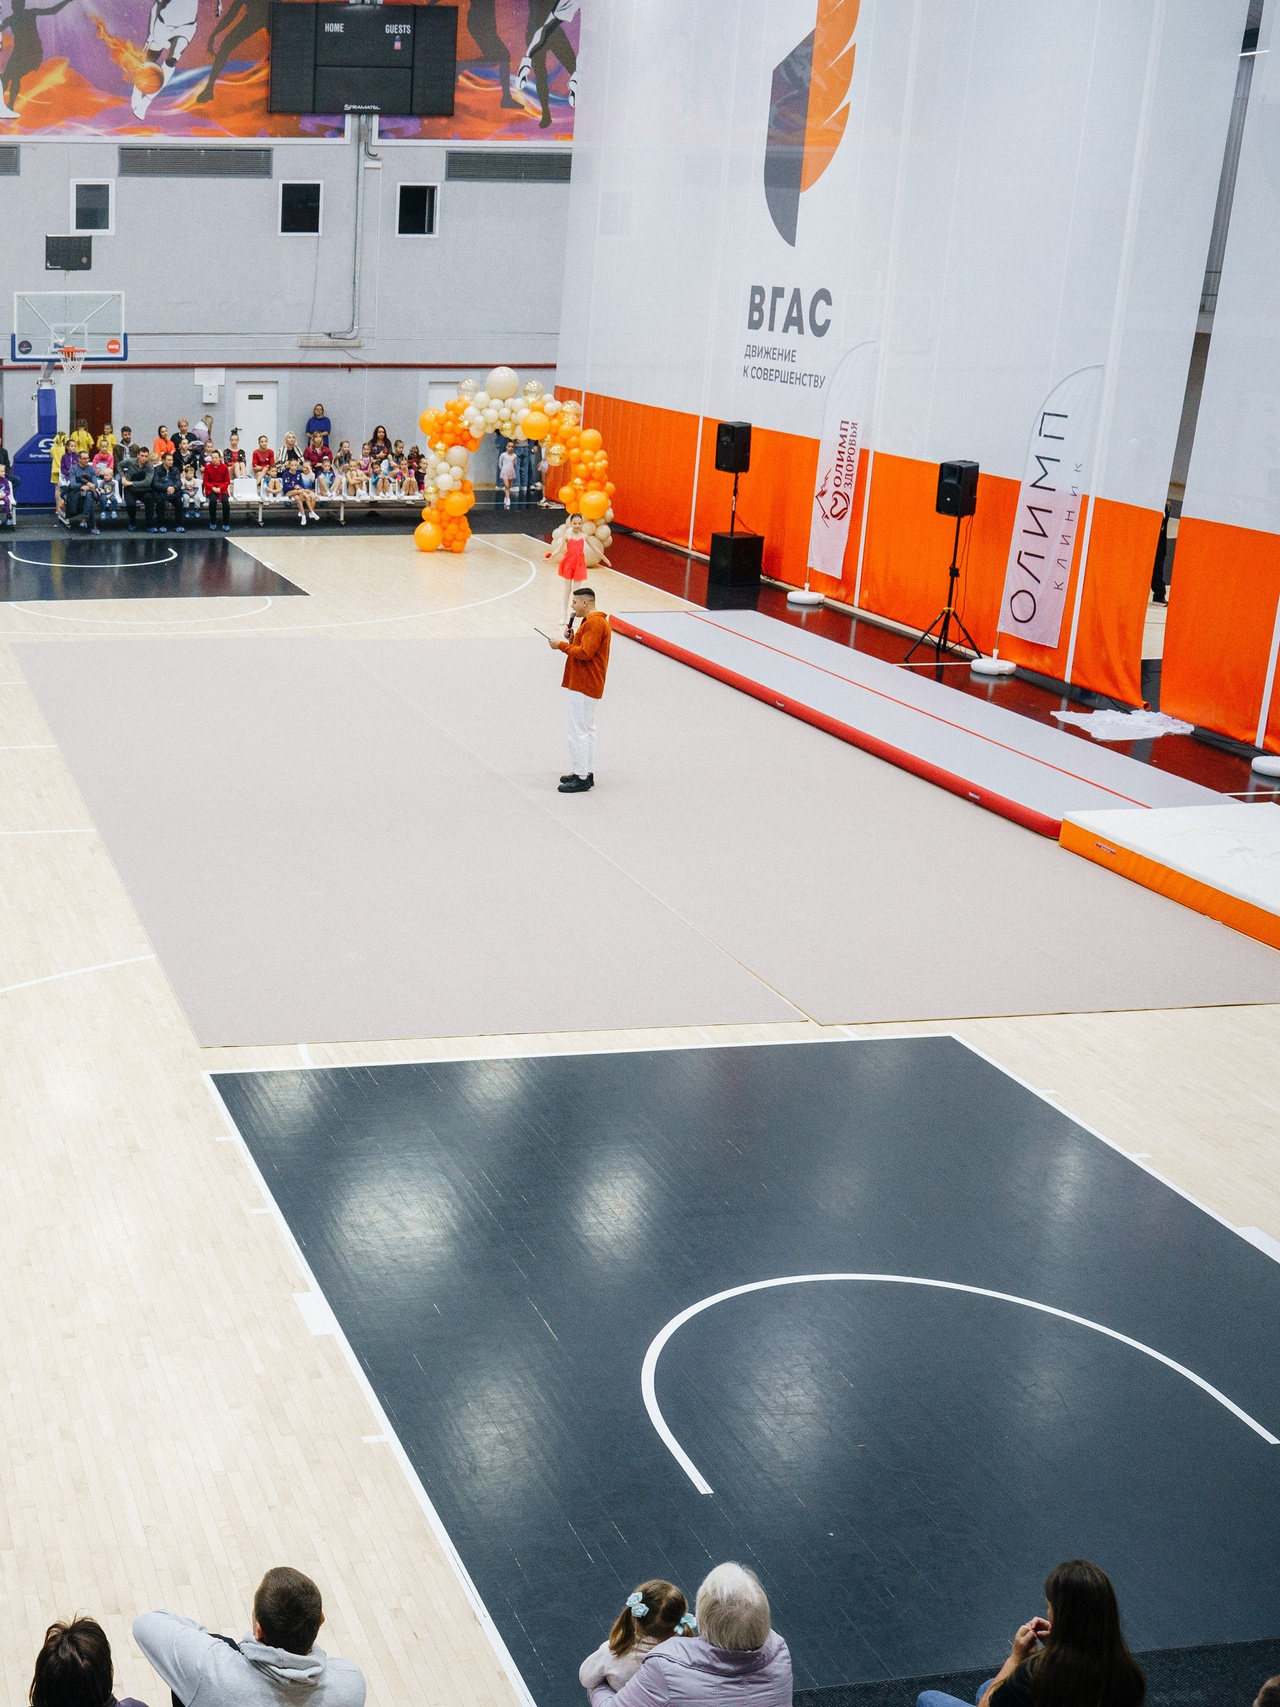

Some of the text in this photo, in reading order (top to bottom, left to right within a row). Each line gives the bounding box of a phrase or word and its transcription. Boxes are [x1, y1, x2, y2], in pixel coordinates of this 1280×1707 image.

[324, 23, 345, 33] HOME
[385, 24, 411, 34] GUESTS
[747, 285, 833, 338] ВГАС
[743, 365, 826, 389] К СОВЕРШЕНСТВУ
[744, 344, 797, 363] ДВИЖЕНИЕ
[833, 420, 850, 488] ОЛИМП
[843, 422, 858, 490] ЗДОРОВЬЯ
[1010, 412, 1069, 624] ОЛИМП
[1053, 462, 1083, 591] КЛИНИК
